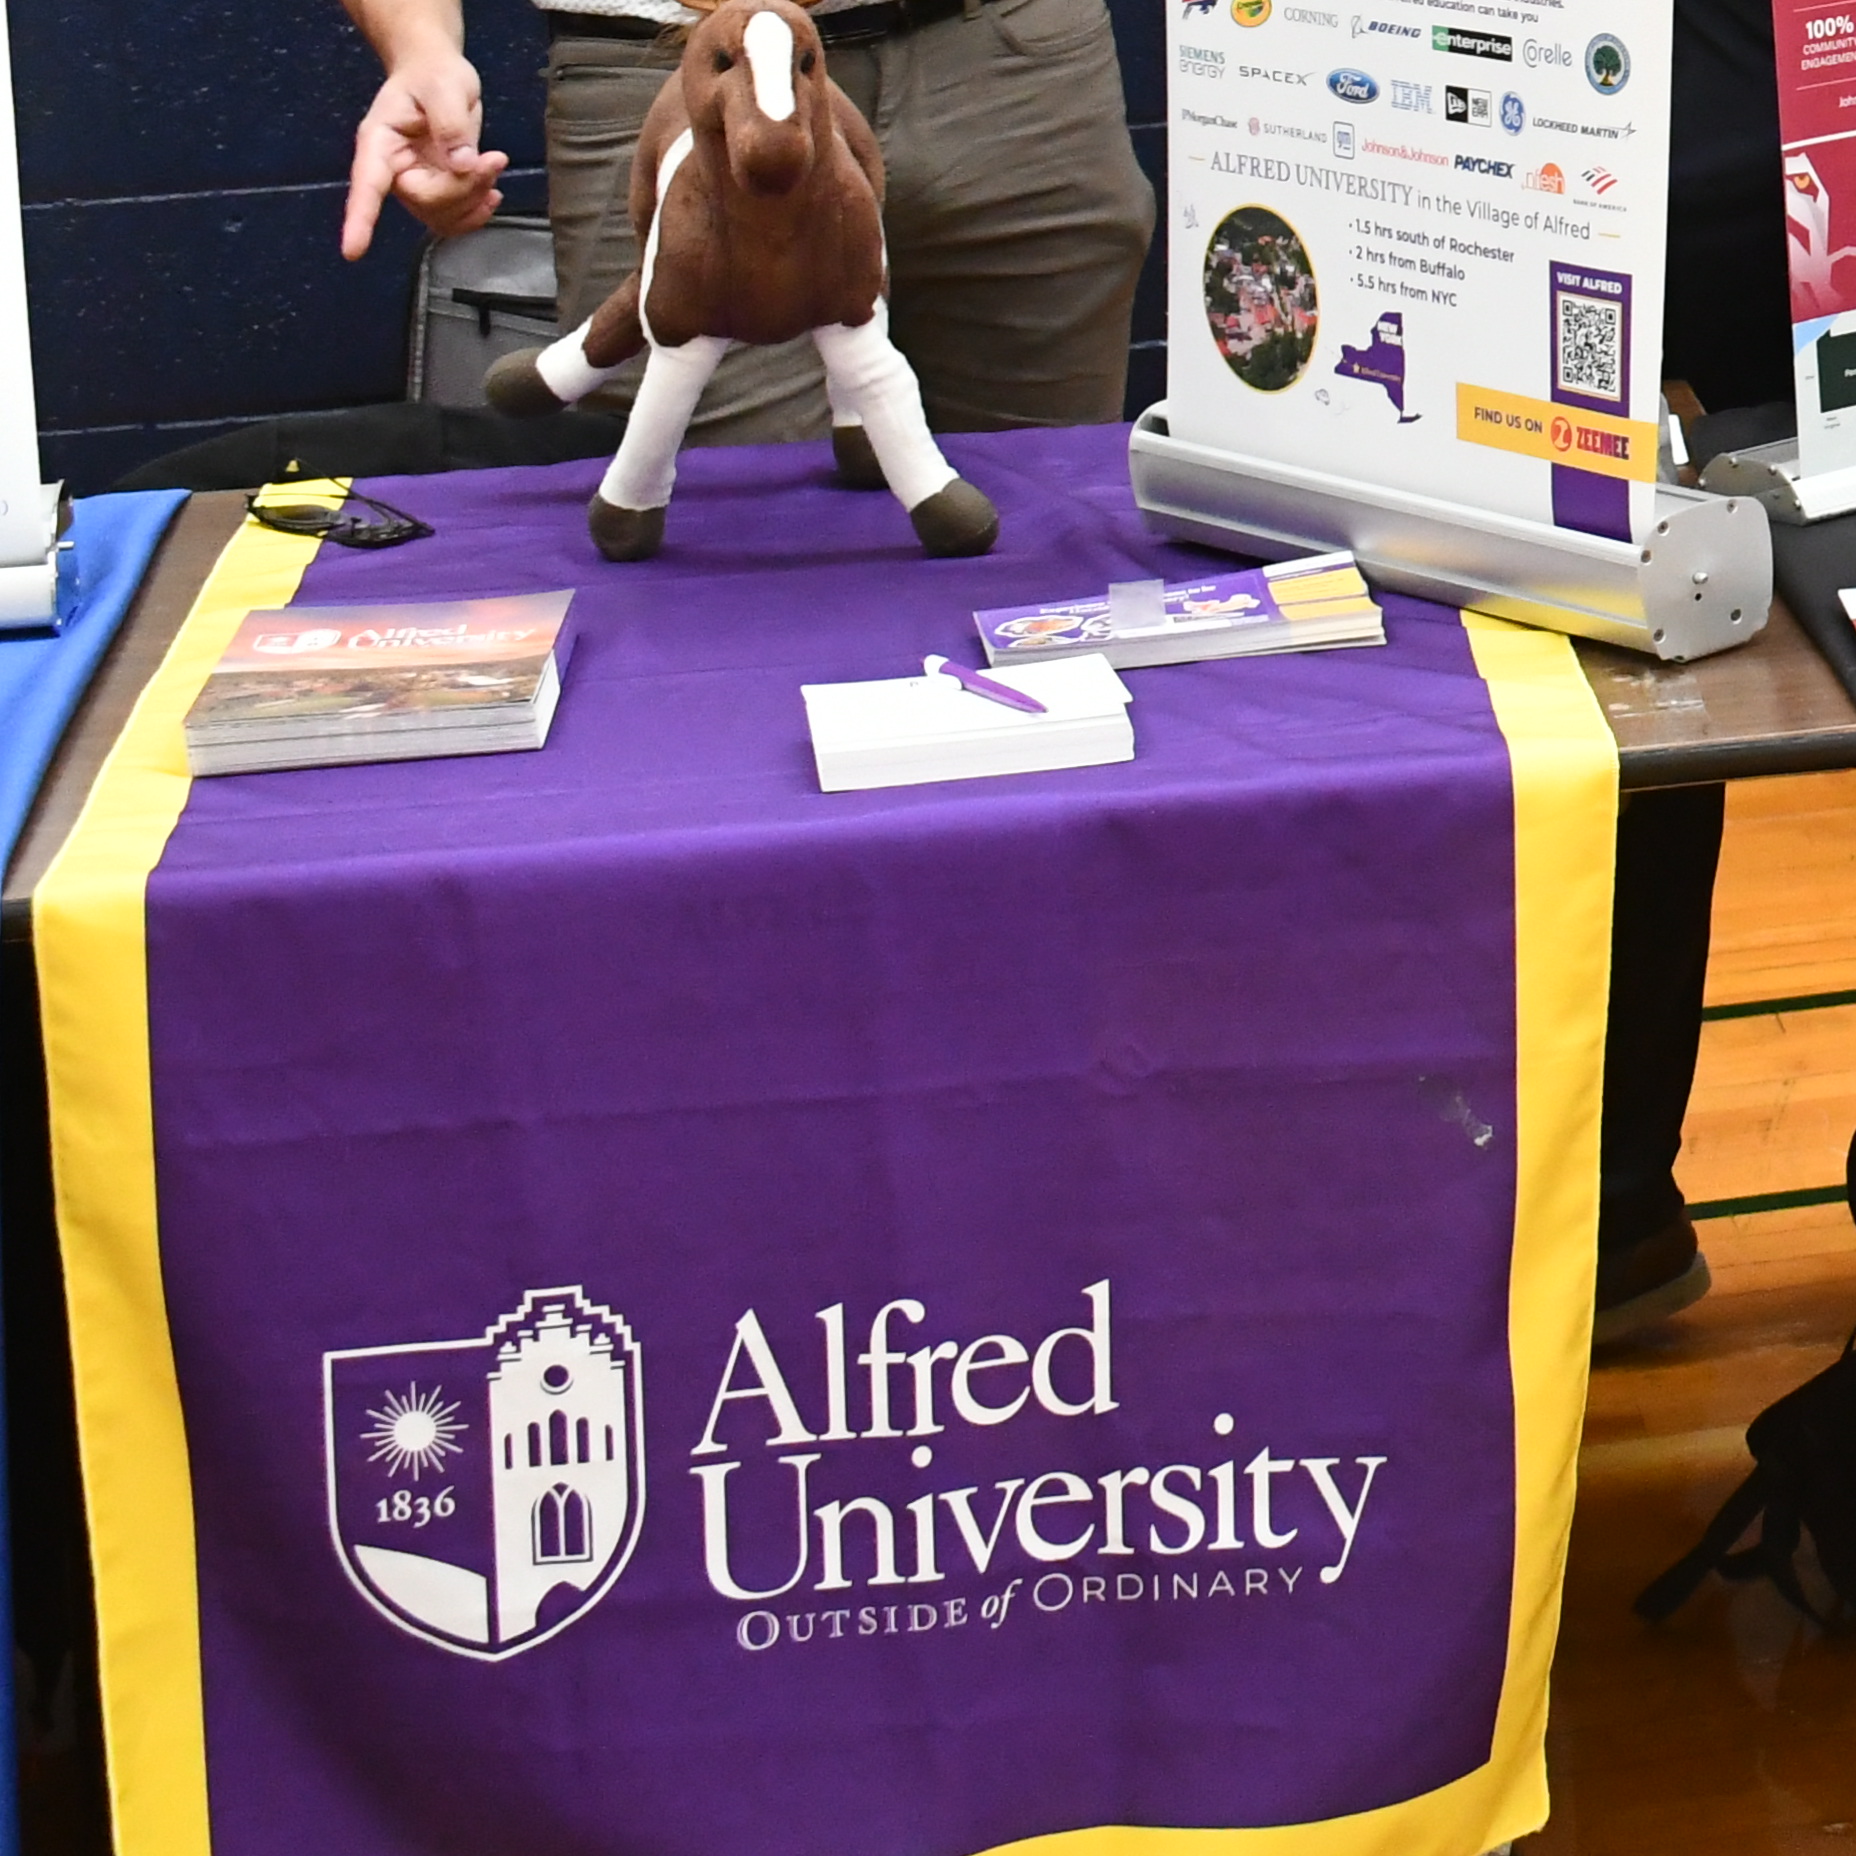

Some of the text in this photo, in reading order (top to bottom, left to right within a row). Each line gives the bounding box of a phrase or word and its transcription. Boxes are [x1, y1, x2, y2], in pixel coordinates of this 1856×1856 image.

[1284, 7, 1421, 38] CORNING BOEING
[1805, 15, 1855, 39] 100%
[1435, 30, 1512, 56] enterprise
[1523, 38, 1573, 68] Corelle
[1239, 65, 1317, 86] SPACEX
[1336, 73, 1369, 98] Ford
[1532, 117, 1619, 139] LOCKHEED MARTIN
[1454, 154, 1515, 179] PAYCHEX
[1211, 151, 1590, 240] ALFRED UNIVERSITY in the Village of Alfred
[1355, 219, 1515, 263] 1.5 hrs south of Rochester
[1355, 246, 1466, 281] 2 hrs from Buffalo
[1357, 274, 1458, 307] 5.5 hrs from NYC
[1557, 272, 1623, 294] VISIT ALFRED
[1474, 406, 1543, 433] FIND US ON
[1576, 426, 1630, 460] ZEEMEE
[348, 627, 536, 649] University
[354, 624, 468, 638] Alfred
[690, 1278, 1121, 1455] Alfred
[375, 1486, 456, 1527] 1836
[687, 1412, 1387, 1603] University
[980, 1580, 1021, 1630] of
